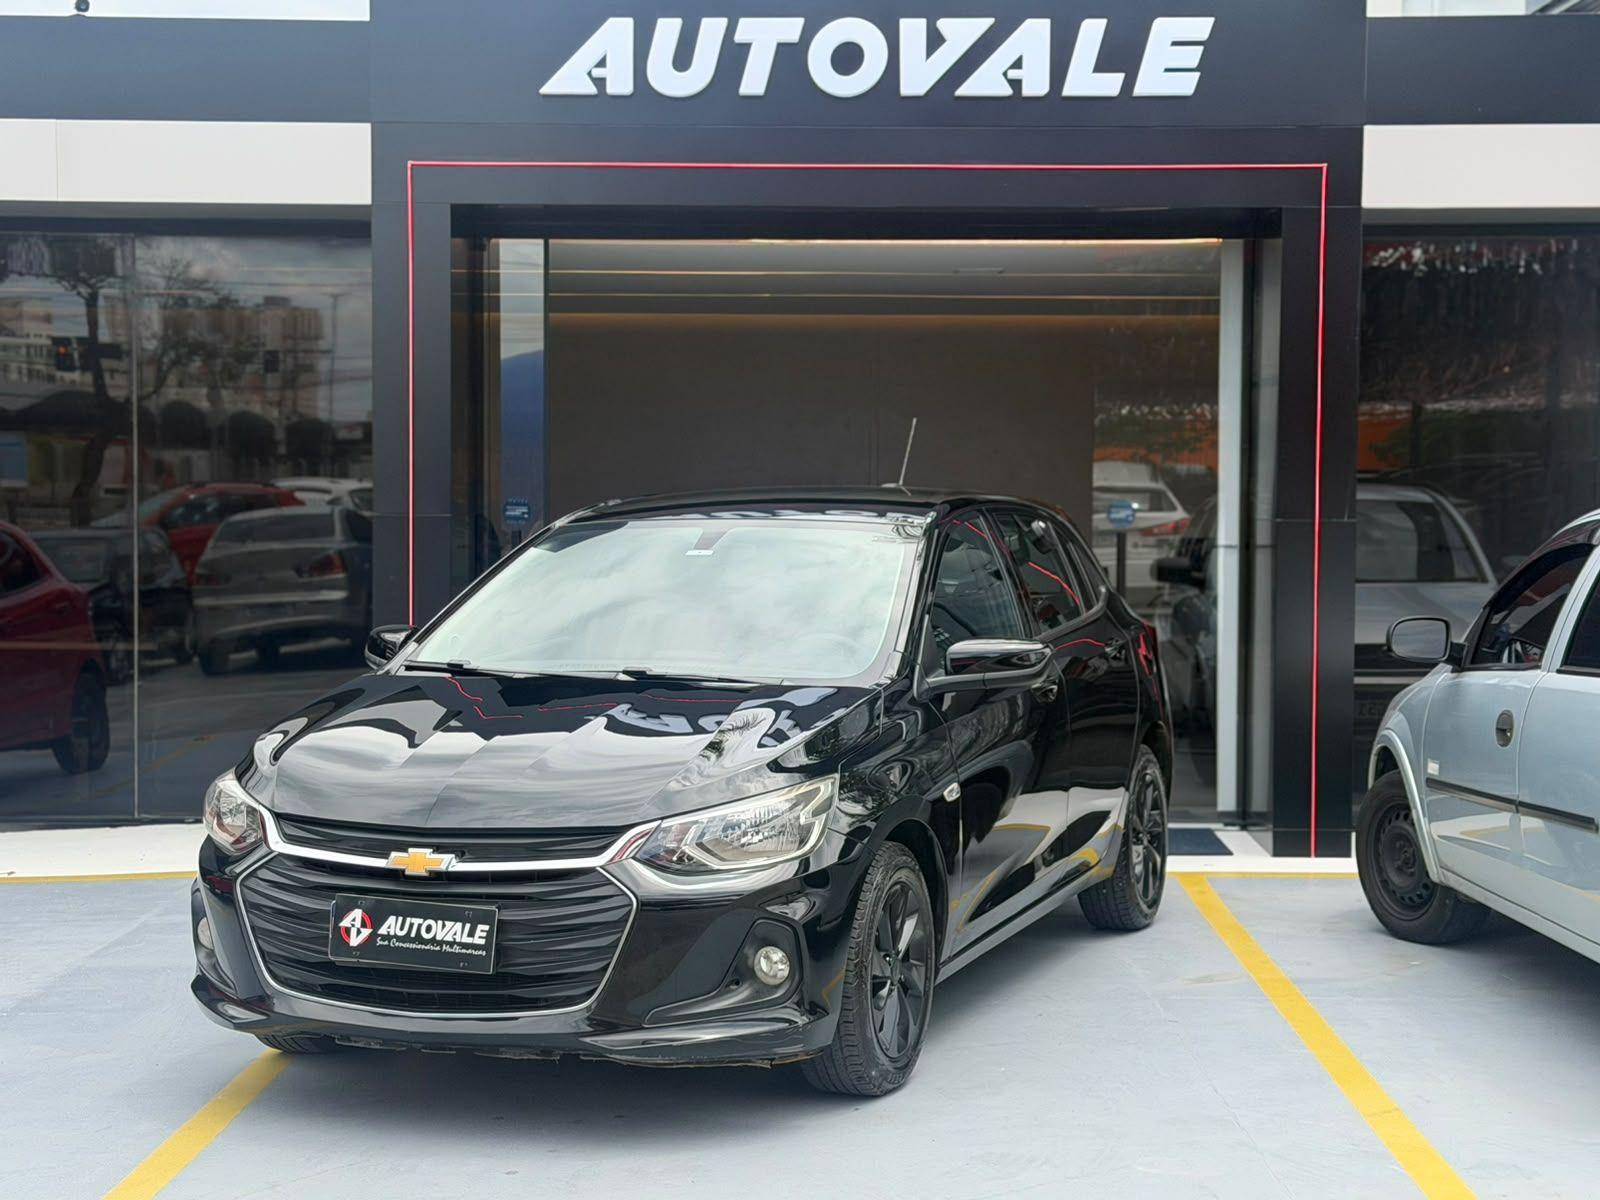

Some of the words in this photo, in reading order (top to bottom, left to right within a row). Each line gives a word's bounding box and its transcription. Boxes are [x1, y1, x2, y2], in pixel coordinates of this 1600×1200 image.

[539, 16, 1215, 98] AUTOVALE
[377, 915, 490, 945] AUTOVALE
[376, 936, 390, 946] Sua
[442, 943, 487, 957] Multimarcas
